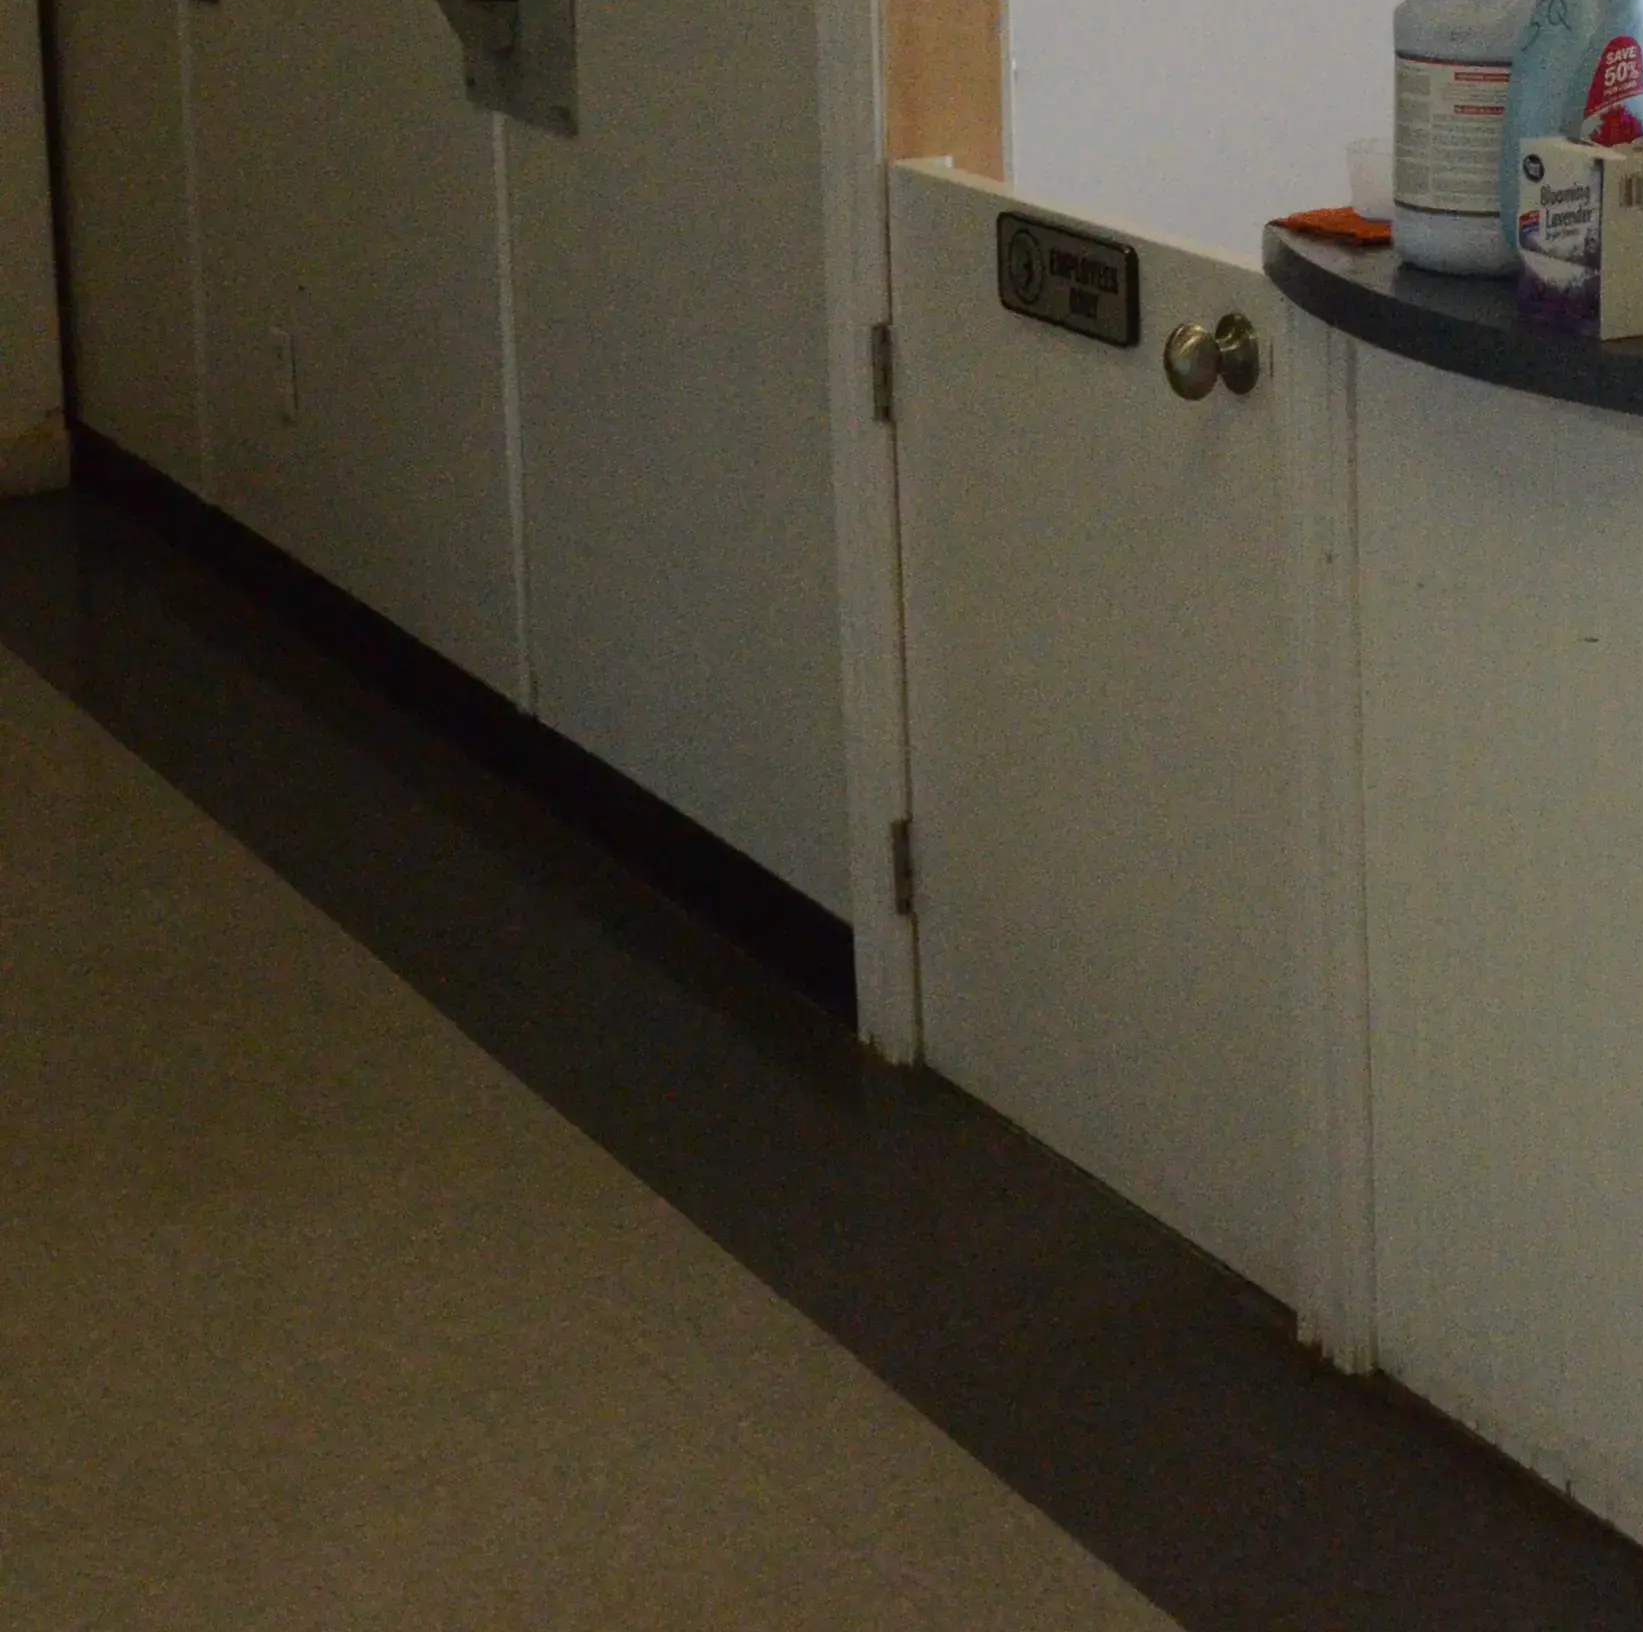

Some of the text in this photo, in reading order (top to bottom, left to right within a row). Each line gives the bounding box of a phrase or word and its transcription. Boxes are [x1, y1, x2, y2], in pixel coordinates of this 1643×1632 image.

[1605, 45, 1637, 65] SAVE
[1603, 61, 1640, 87] 50%
[1540, 182, 1591, 206] Blooming
[1546, 206, 1592, 229] Lavender
